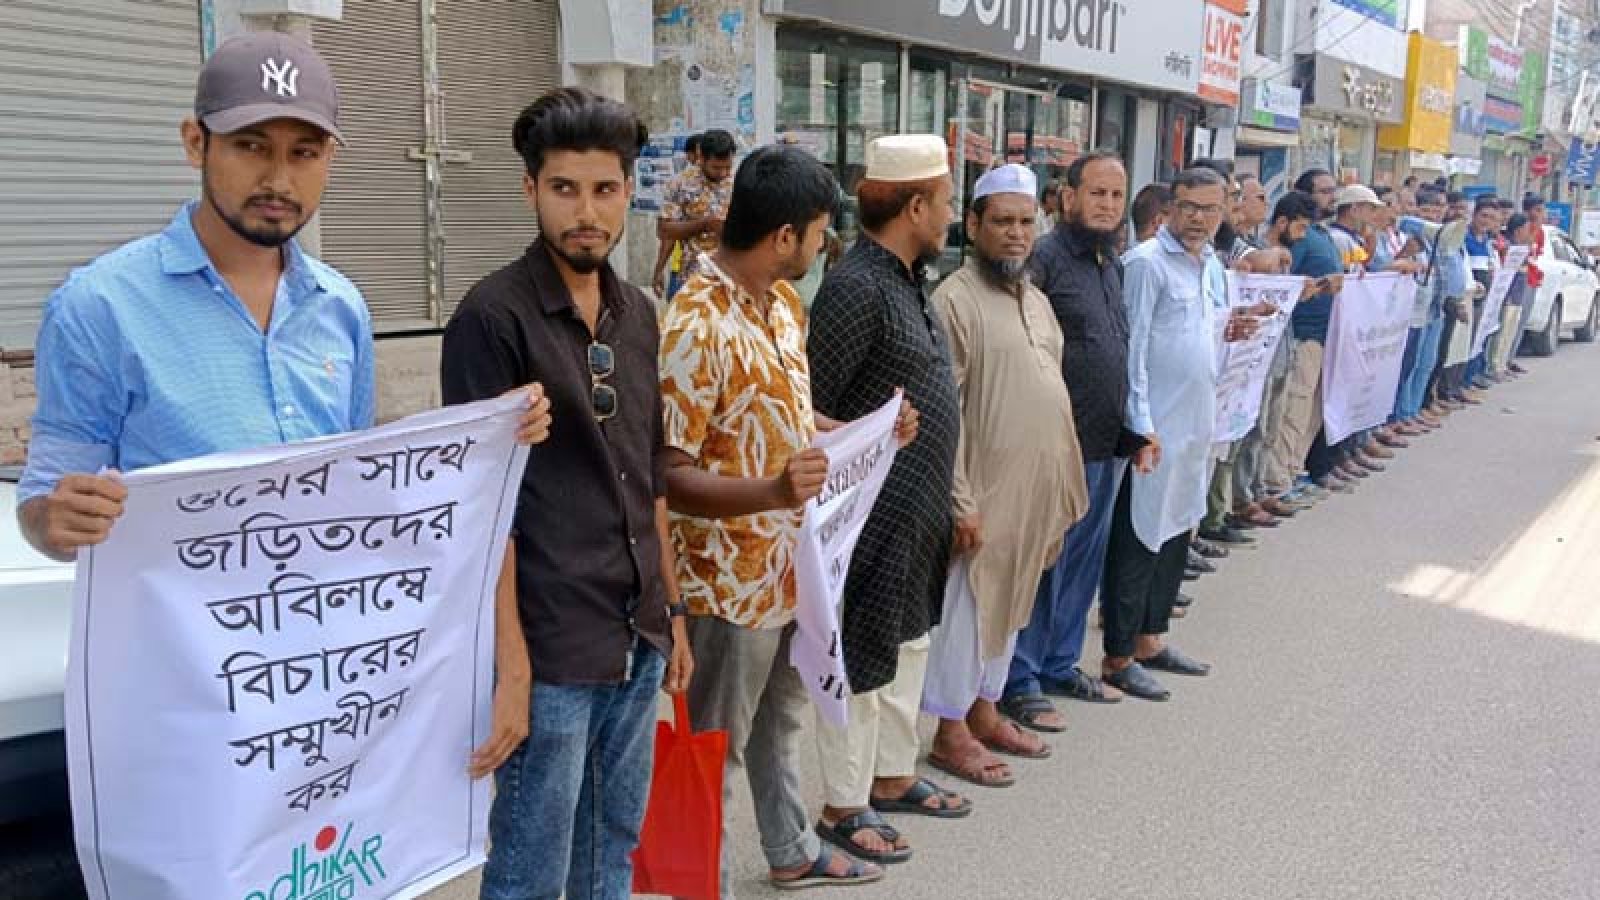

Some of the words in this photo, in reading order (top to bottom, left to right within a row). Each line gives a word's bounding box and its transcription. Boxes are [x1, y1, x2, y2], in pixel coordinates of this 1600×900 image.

[260, 57, 299, 97] NY
[356, 436, 476, 488] সাথে
[173, 501, 458, 572] জড়িতদের
[205, 567, 431, 636] অবিলম্বে
[215, 627, 427, 713] বিচারের
[228, 688, 409, 772] সম্মুখীন
[284, 760, 359, 813] কর
